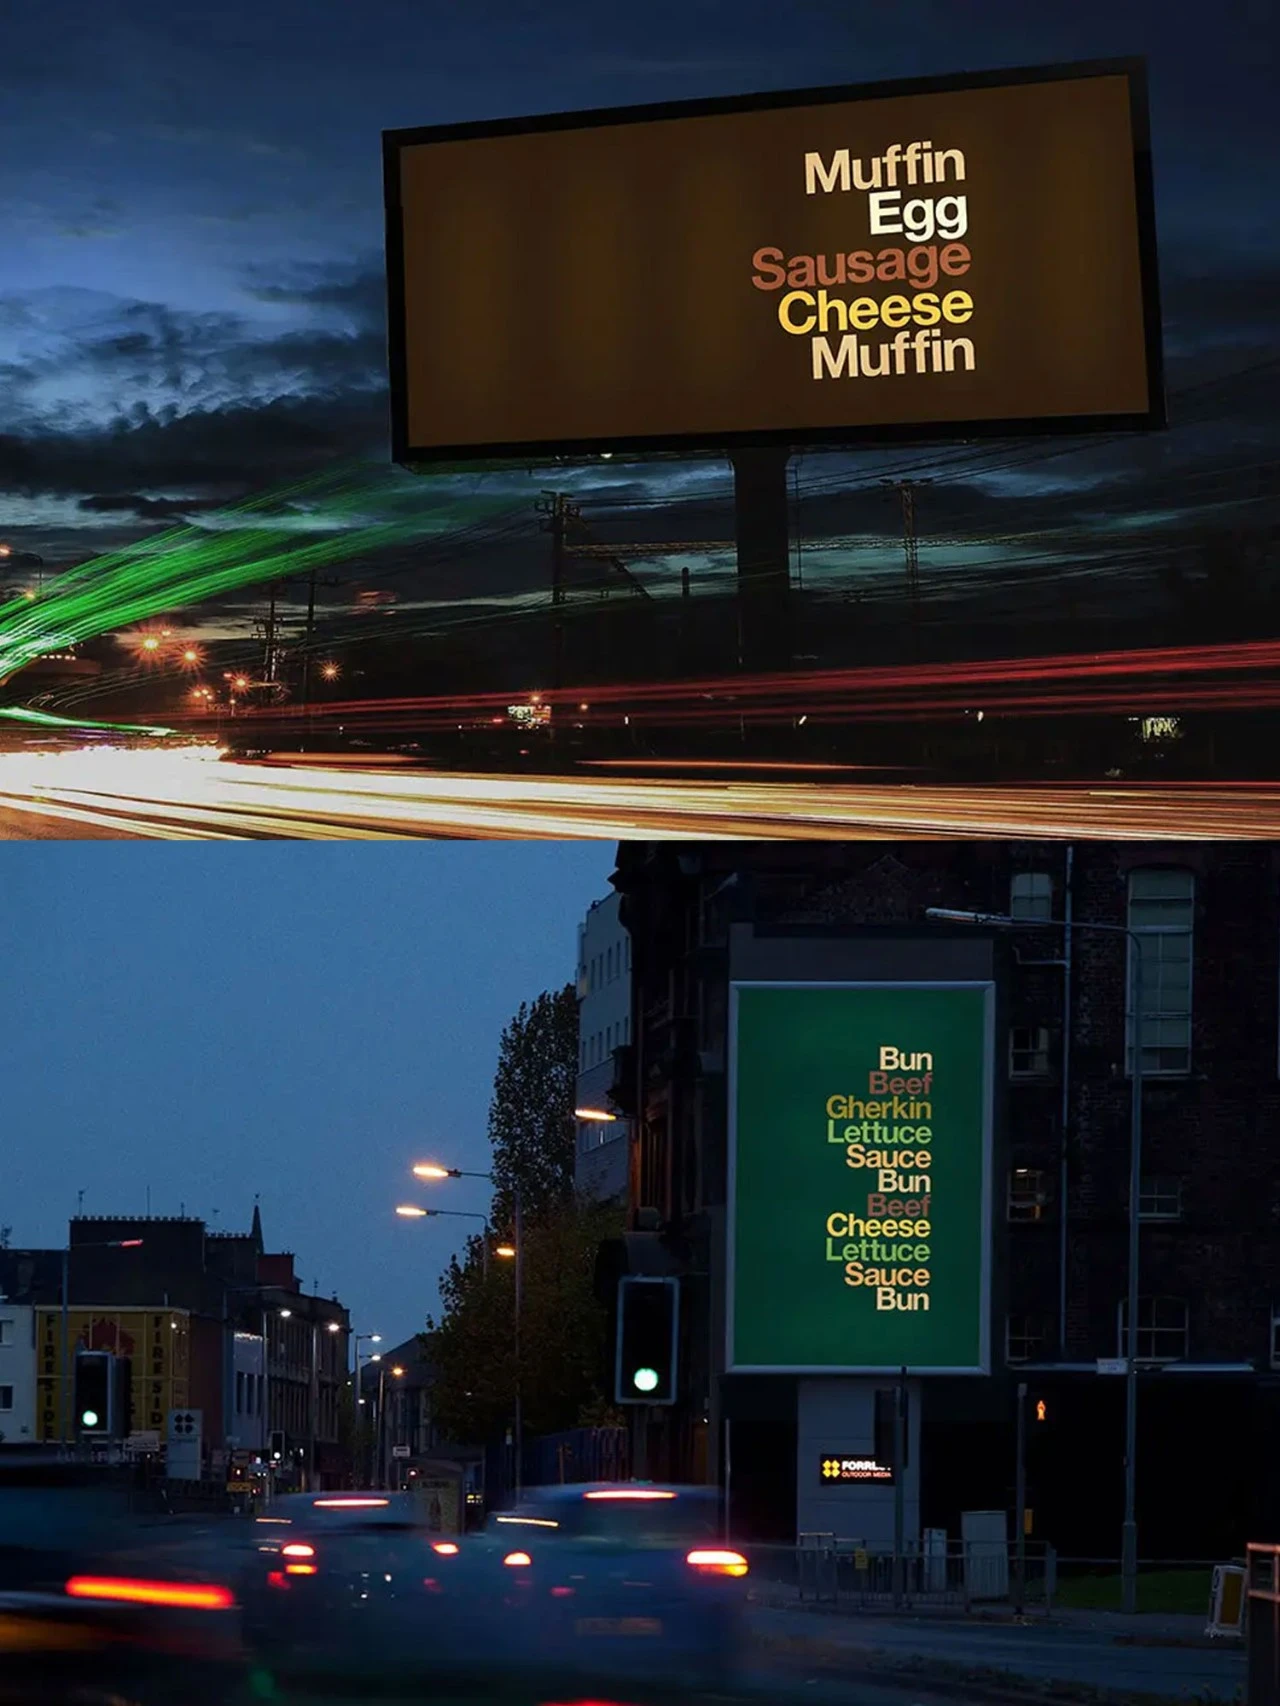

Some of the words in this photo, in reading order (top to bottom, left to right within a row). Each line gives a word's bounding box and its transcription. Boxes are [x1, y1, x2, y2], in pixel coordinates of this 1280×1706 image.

[804, 141, 966, 195] Muffin
[869, 190, 968, 243] Egg
[751, 242, 971, 291] Sausage
[778, 289, 974, 335] Cheese
[811, 329, 976, 380] Muffin
[879, 1046, 933, 1071] Bun
[869, 1071, 934, 1095] Beef
[825, 1094, 932, 1120] Gherkin
[827, 1119, 932, 1144] Lettuce
[846, 1144, 932, 1168] Sauce
[878, 1169, 931, 1193] Bun
[867, 1193, 931, 1217] Beef
[826, 1212, 931, 1238] Cheese
[825, 1237, 931, 1262] Lettuce
[844, 1262, 930, 1287] Sauce
[876, 1286, 930, 1311] Bun
[151, 1316, 163, 1430] FIRESID
